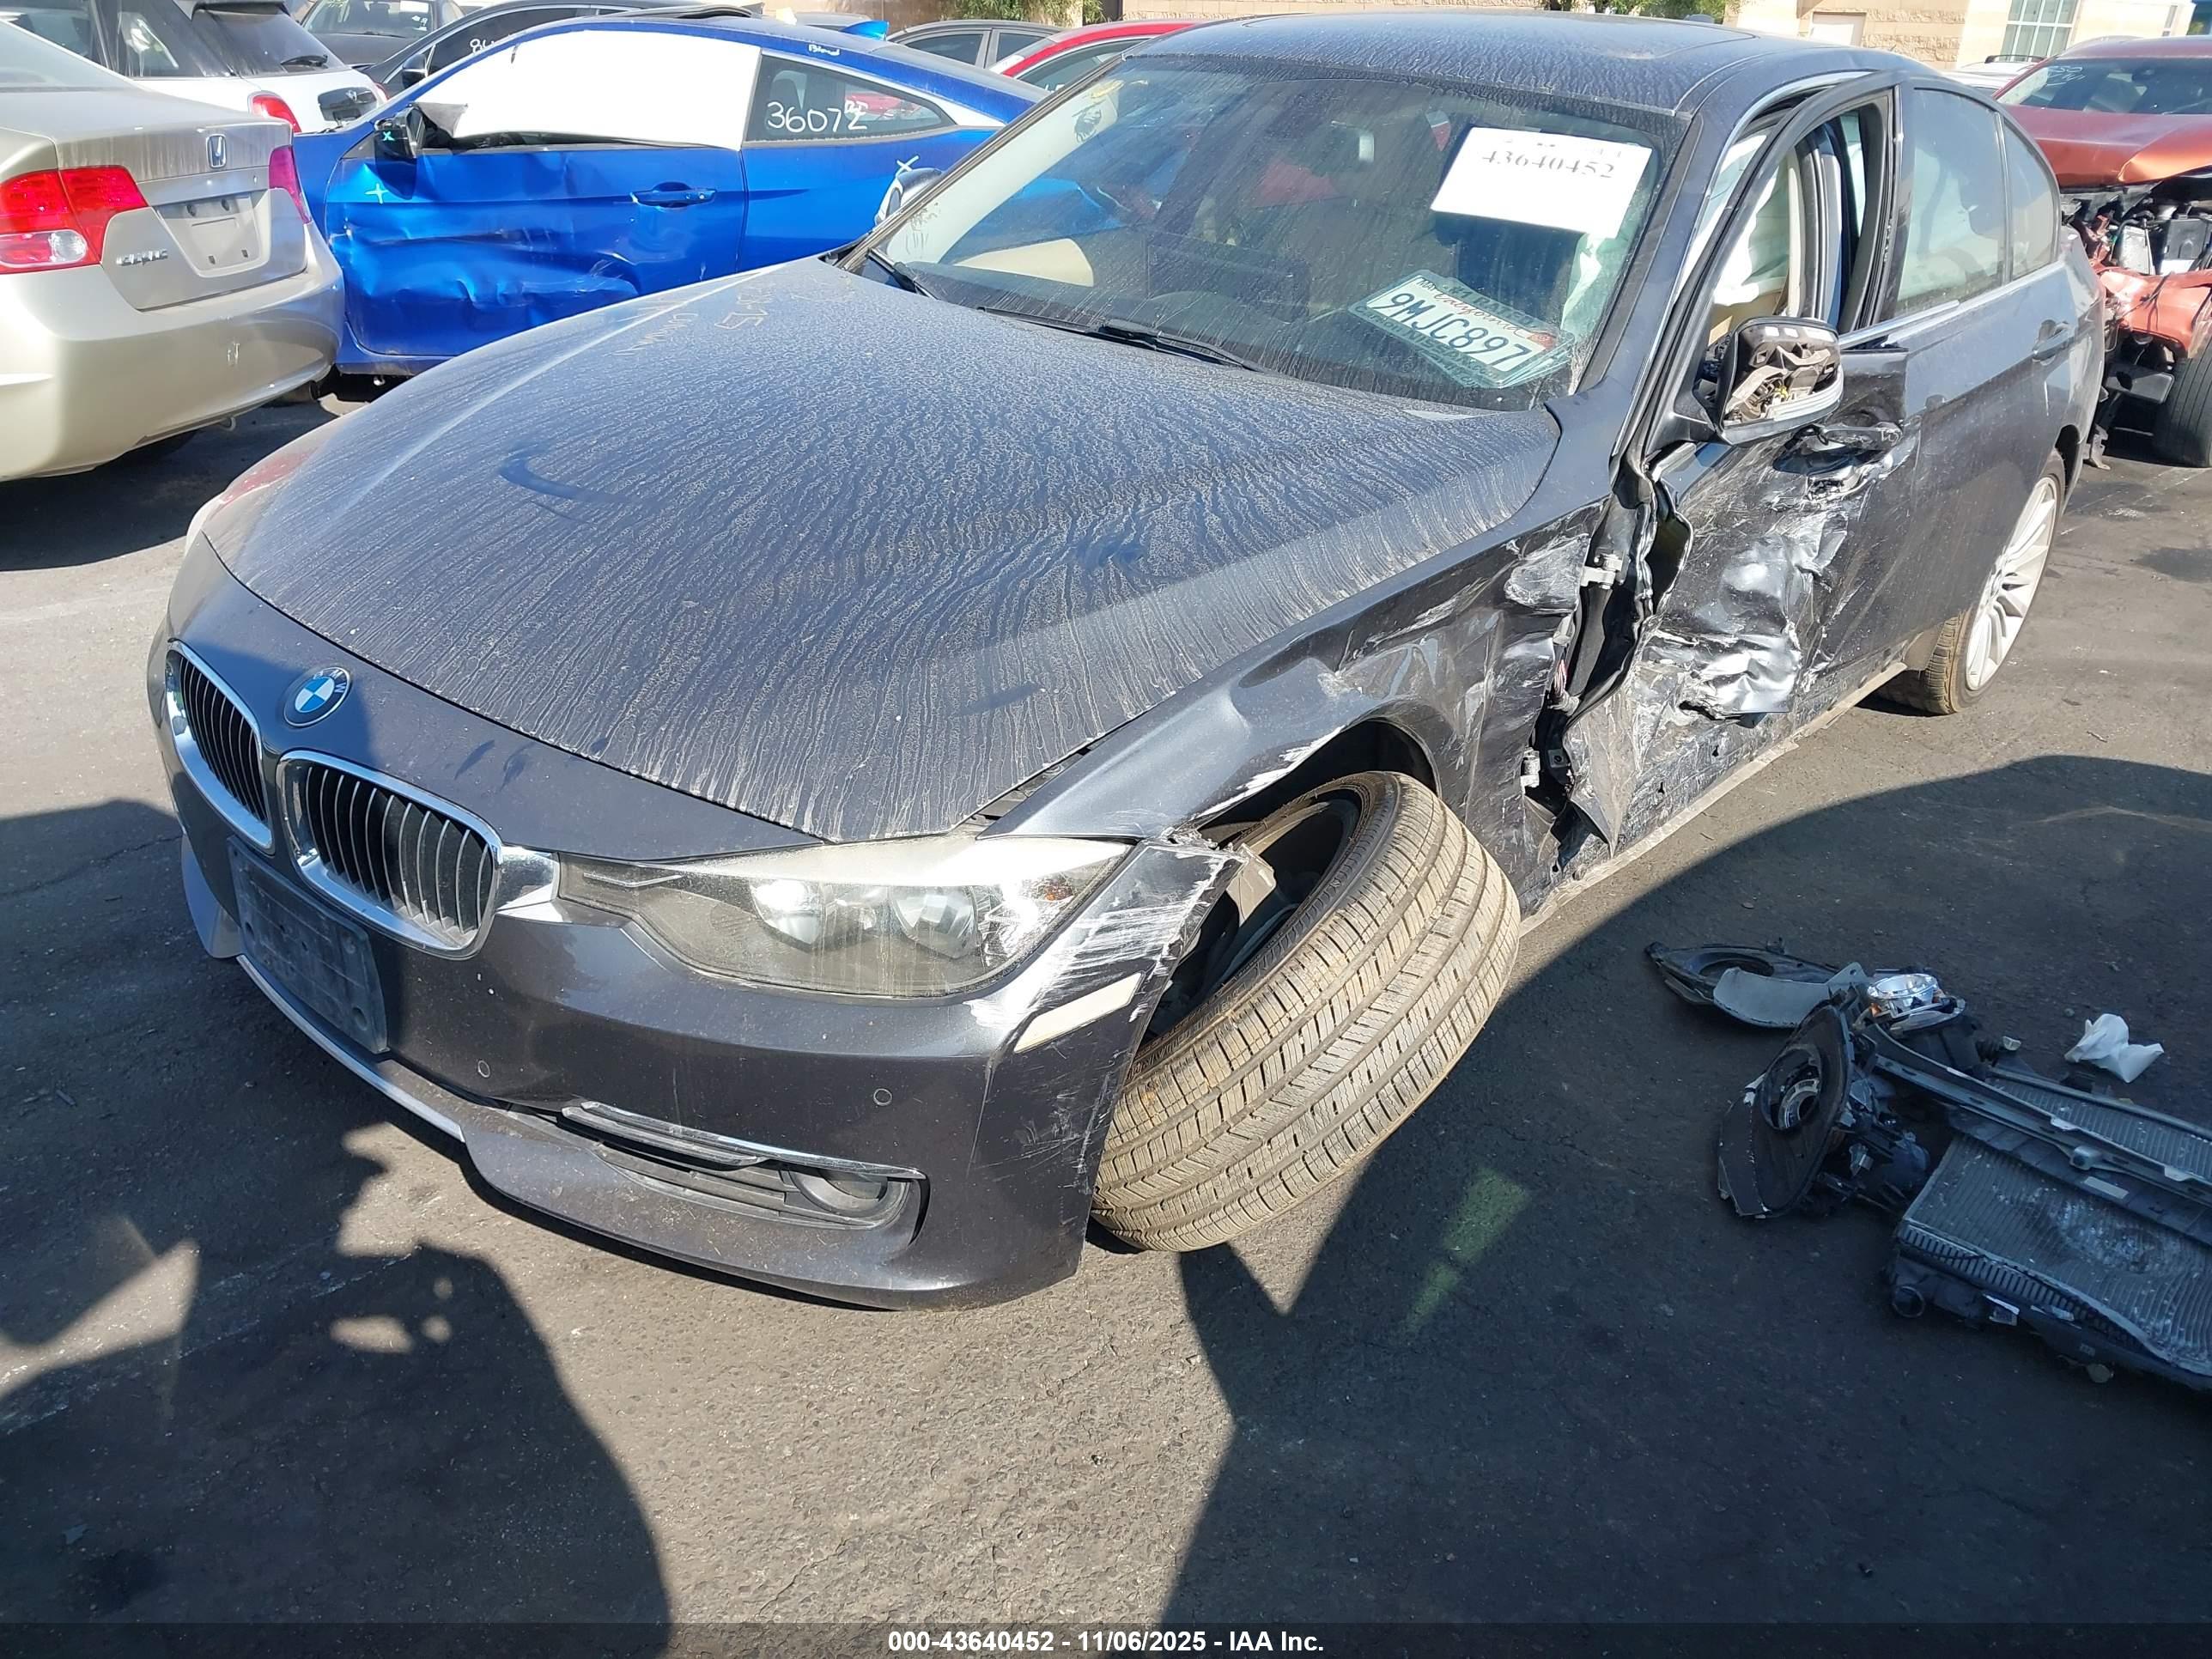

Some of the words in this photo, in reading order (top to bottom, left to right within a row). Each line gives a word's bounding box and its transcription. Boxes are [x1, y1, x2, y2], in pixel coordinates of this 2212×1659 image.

[1482, 149, 1614, 179] 43640452
[1372, 293, 1533, 366] 9MJC897
[1434, 293, 1525, 338] California
